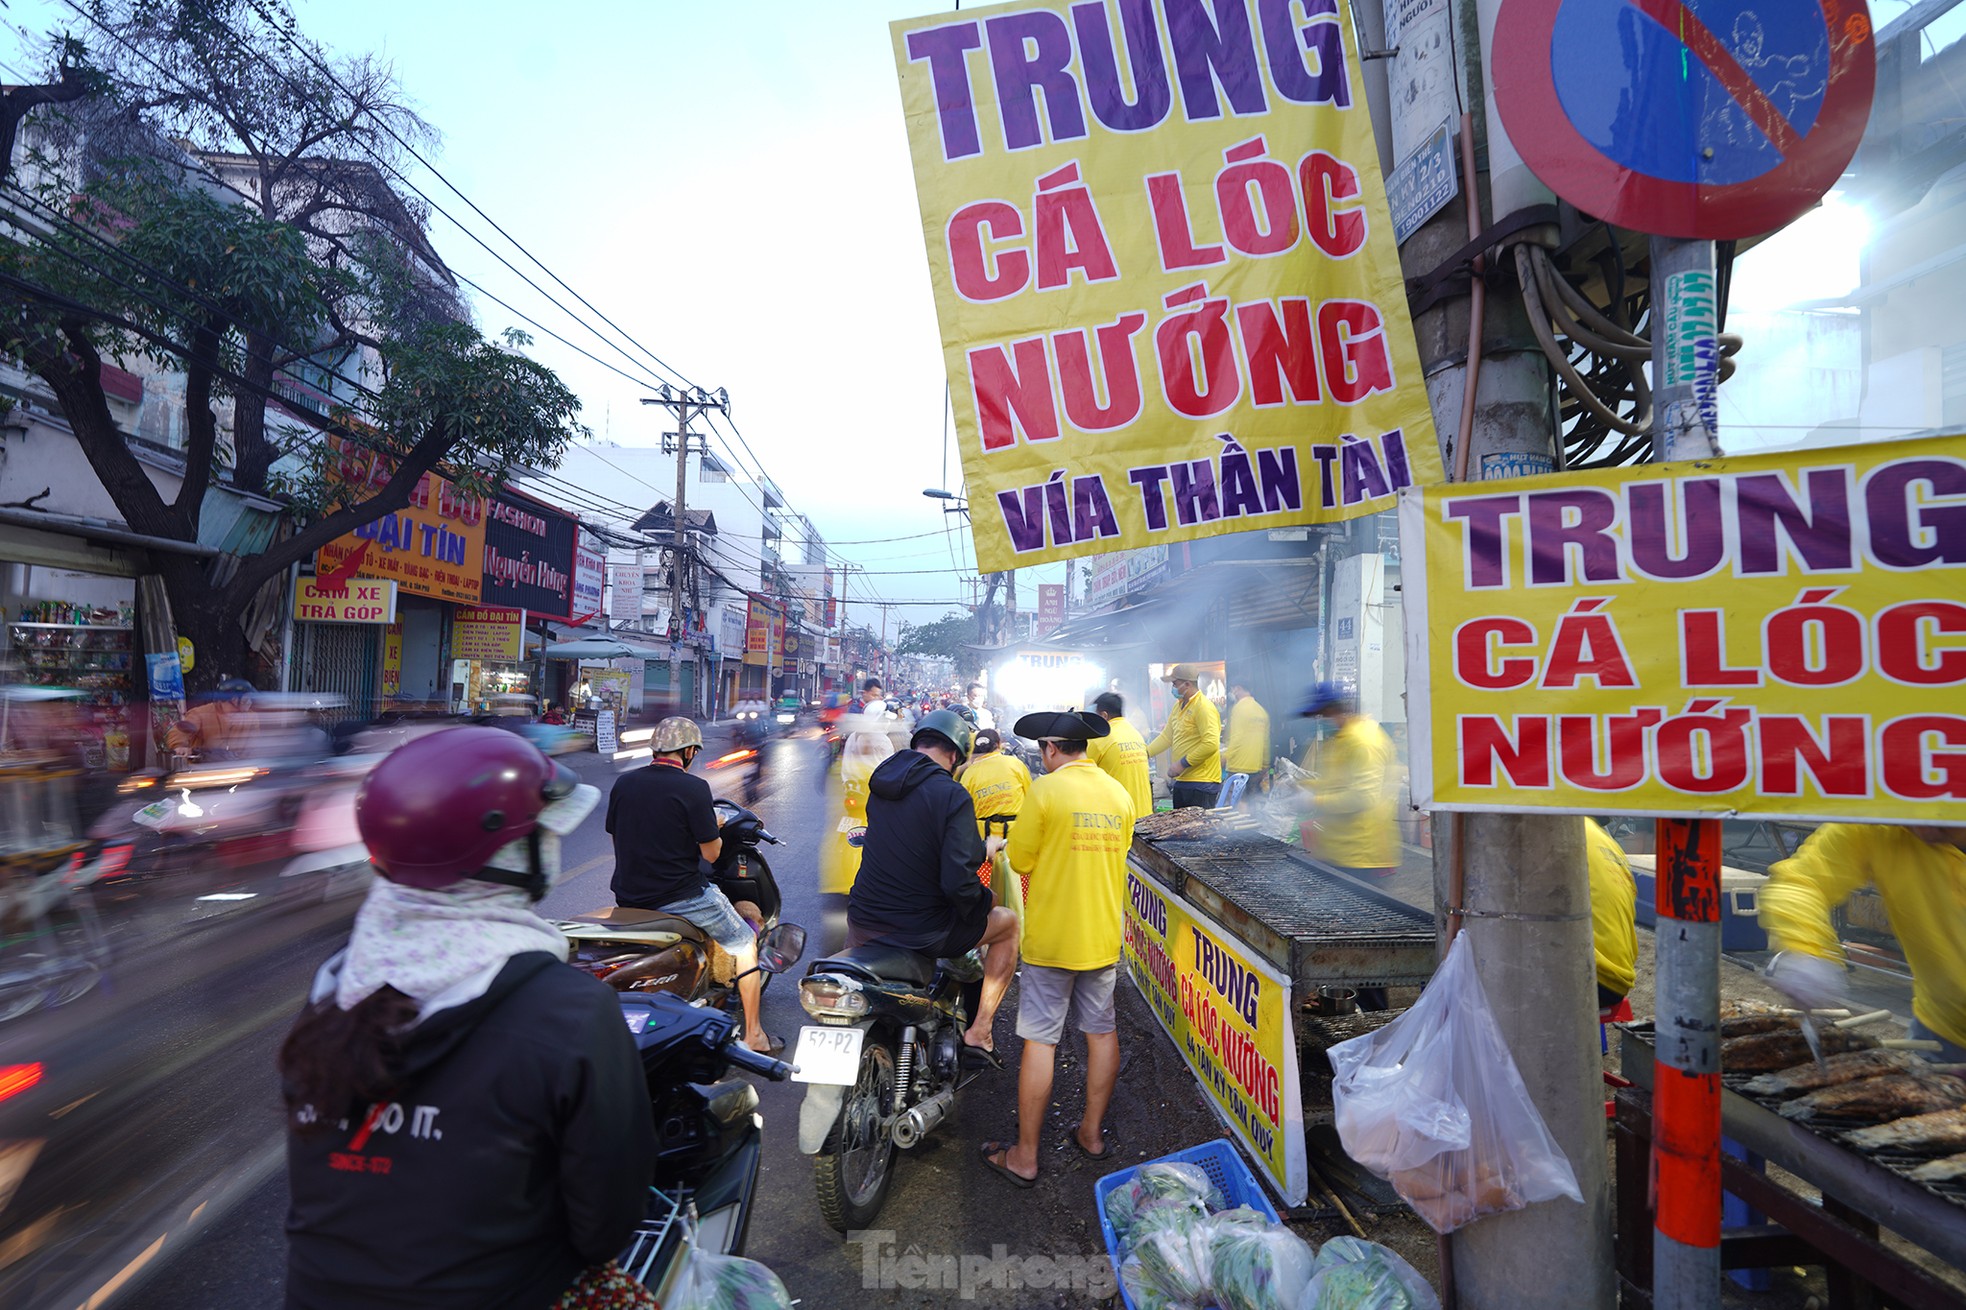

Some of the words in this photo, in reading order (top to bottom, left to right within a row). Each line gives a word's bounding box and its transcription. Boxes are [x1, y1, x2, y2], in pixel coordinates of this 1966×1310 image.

[907, 0, 1352, 160] TRUNG
[1420, 152, 1442, 182] 2/3
[948, 163, 1118, 301] CÁ
[1146, 136, 1368, 270] LÓC
[1400, 183, 1450, 236] 19001122
[968, 283, 1395, 451] NƯỚNG
[998, 471, 1119, 552] VÍA
[1130, 434, 1301, 531] THẦN
[1313, 428, 1411, 508] TÀI
[418, 523, 467, 566] TÍN
[486, 498, 546, 538] FASHION
[1447, 460, 1966, 588] TRUNG
[378, 557, 387, 570] XE
[300, 602, 336, 619] TRẢ
[344, 604, 383, 620] GÓP
[357, 587, 381, 600] XE
[490, 612, 504, 623] ĐẠI
[506, 611, 519, 622] TÍN
[1340, 619, 1352, 631] 44
[1455, 598, 1639, 689] CÁ
[1682, 587, 1966, 687] LÓC
[389, 645, 398, 660] XE
[1460, 699, 1966, 798] NƯỚNG
[1072, 812, 1122, 830] TRUNG
[1127, 872, 1168, 939] TRUNG
[1192, 925, 1260, 1030] TRUNG
[808, 1030, 854, 1054] 52-P2
[1180, 972, 1196, 1028] CÁ
[1196, 988, 1219, 1057] LÓC
[1221, 1017, 1280, 1130] NƯỚNG
[1186, 1031, 1196, 1059] 44
[1197, 1044, 1212, 1083] TÂN
[1227, 1083, 1248, 1130] TÂN
[1250, 1111, 1274, 1162] QUÝ
